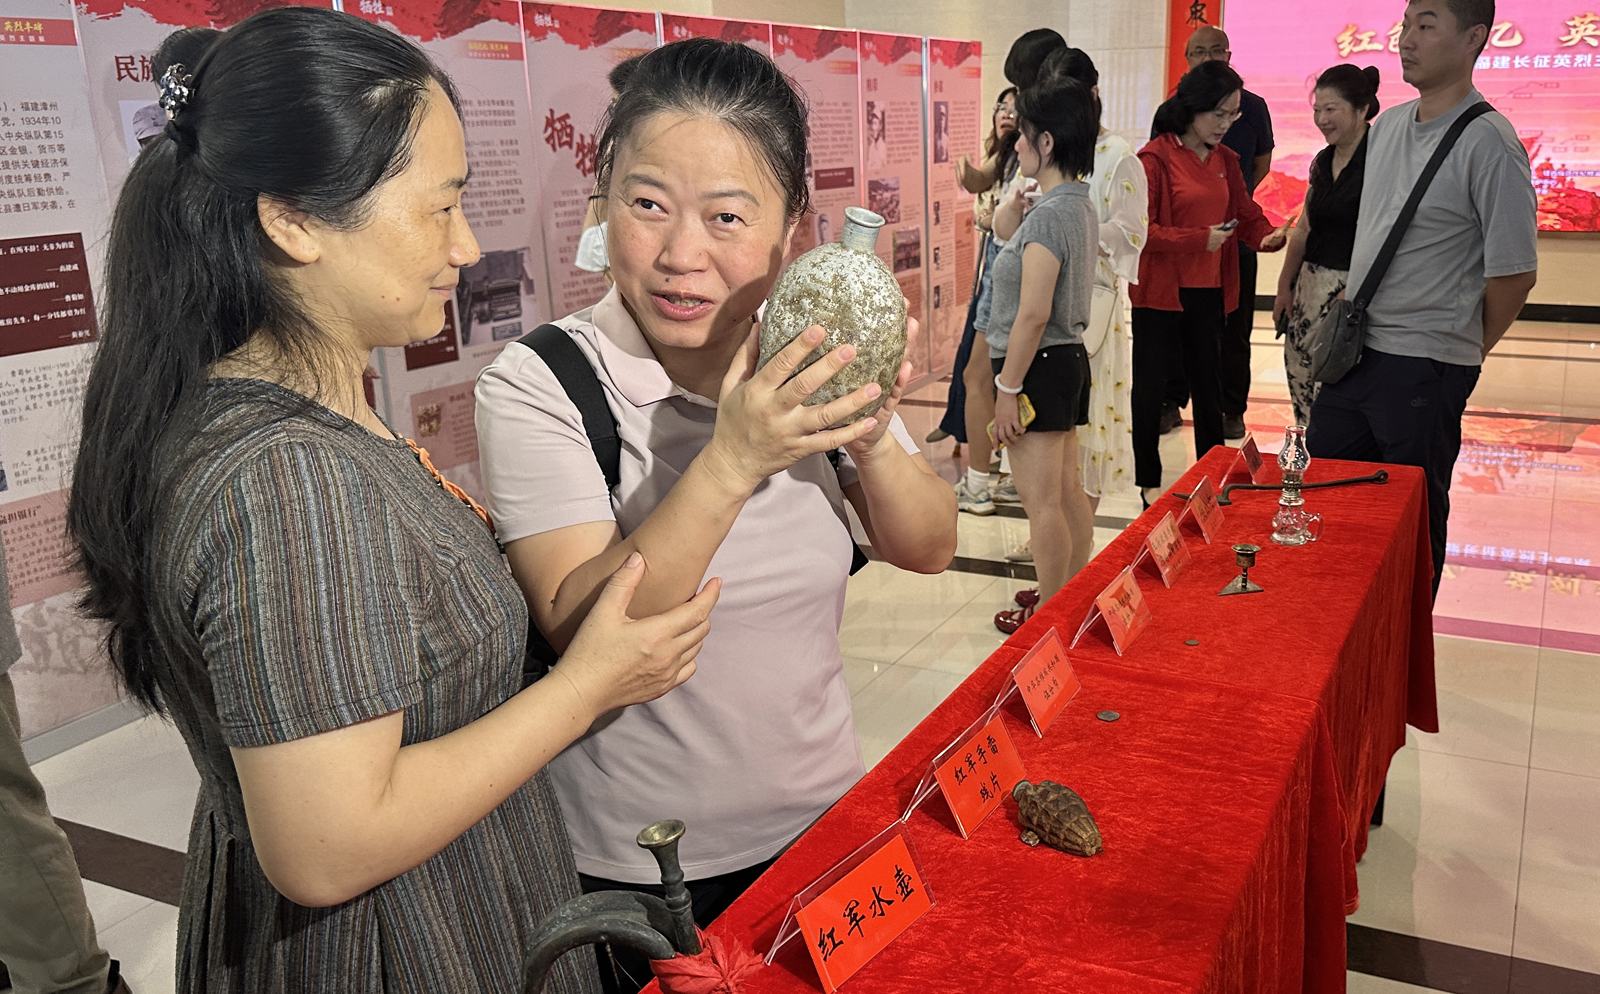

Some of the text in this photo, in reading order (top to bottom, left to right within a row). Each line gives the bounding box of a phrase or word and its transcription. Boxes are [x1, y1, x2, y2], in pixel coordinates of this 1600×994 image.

[0, 157, 69, 170] 提供关键经济保
[954, 734, 999, 787] 红军手雷
[817, 864, 915, 962] 红军水壶
